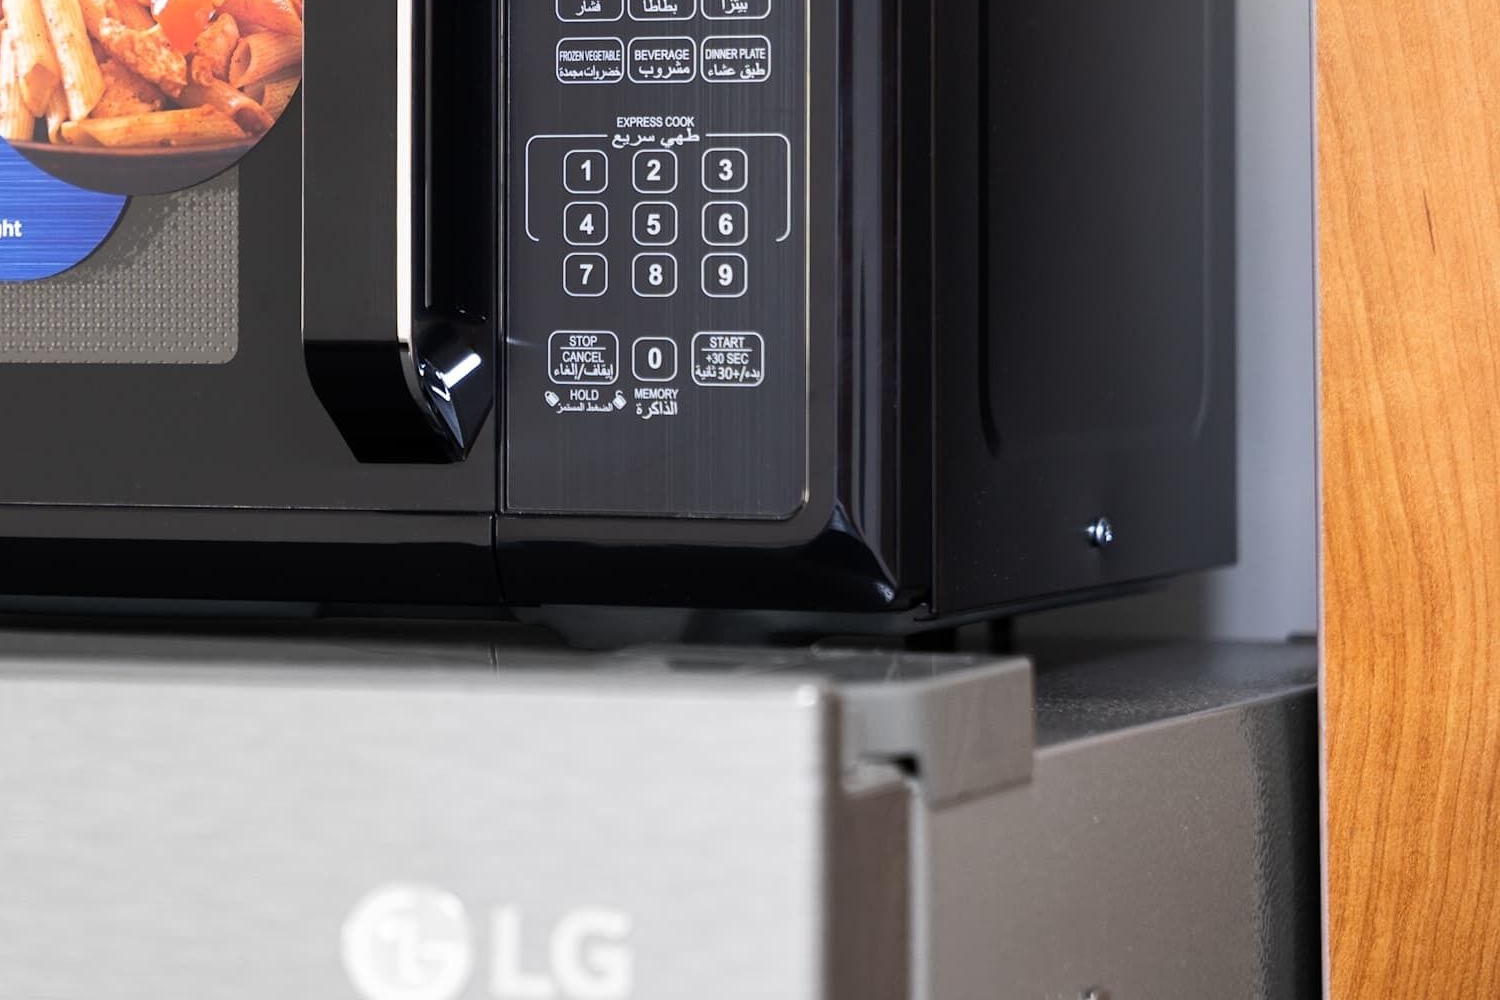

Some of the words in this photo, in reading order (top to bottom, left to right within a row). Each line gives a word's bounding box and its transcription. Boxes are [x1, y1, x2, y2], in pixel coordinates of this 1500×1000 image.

[576, 0, 601, 16] فشار
[643, 0, 678, 15] بطاطا
[560, 50, 584, 61] FROZEN
[584, 50, 620, 61] VEGETABLE
[634, 50, 690, 60] BEVERAGE
[705, 49, 738, 59] DINNER
[740, 48, 765, 59] PLATE
[639, 61, 690, 78] مشروب
[708, 64, 736, 77] عشاء
[740, 62, 765, 79] طبق
[617, 117, 662, 127] EXPRESS
[665, 116, 695, 127] COOK
[612, 133, 655, 148] سريع
[660, 128, 700, 148] طهي
[580, 160, 591, 181] 1
[647, 160, 660, 181] 2
[719, 160, 733, 180] 3
[580, 214, 593, 234] 4
[647, 214, 660, 234] 5
[719, 213, 733, 234] 6
[580, 264, 593, 285] 7
[649, 264, 662, 285] 8
[718, 264, 733, 285] 9
[569, 336, 597, 346] STOP
[709, 337, 745, 348] START
[562, 351, 604, 362] CANCEL
[648, 347, 662, 369] 0
[706, 353, 724, 364] +30
[726, 353, 749, 364] SEC
[570, 390, 599, 400] HOLD
[634, 389, 678, 399] MEMORY
[636, 401, 677, 419] الذاكرة
[489, 904, 635, 999] LG
